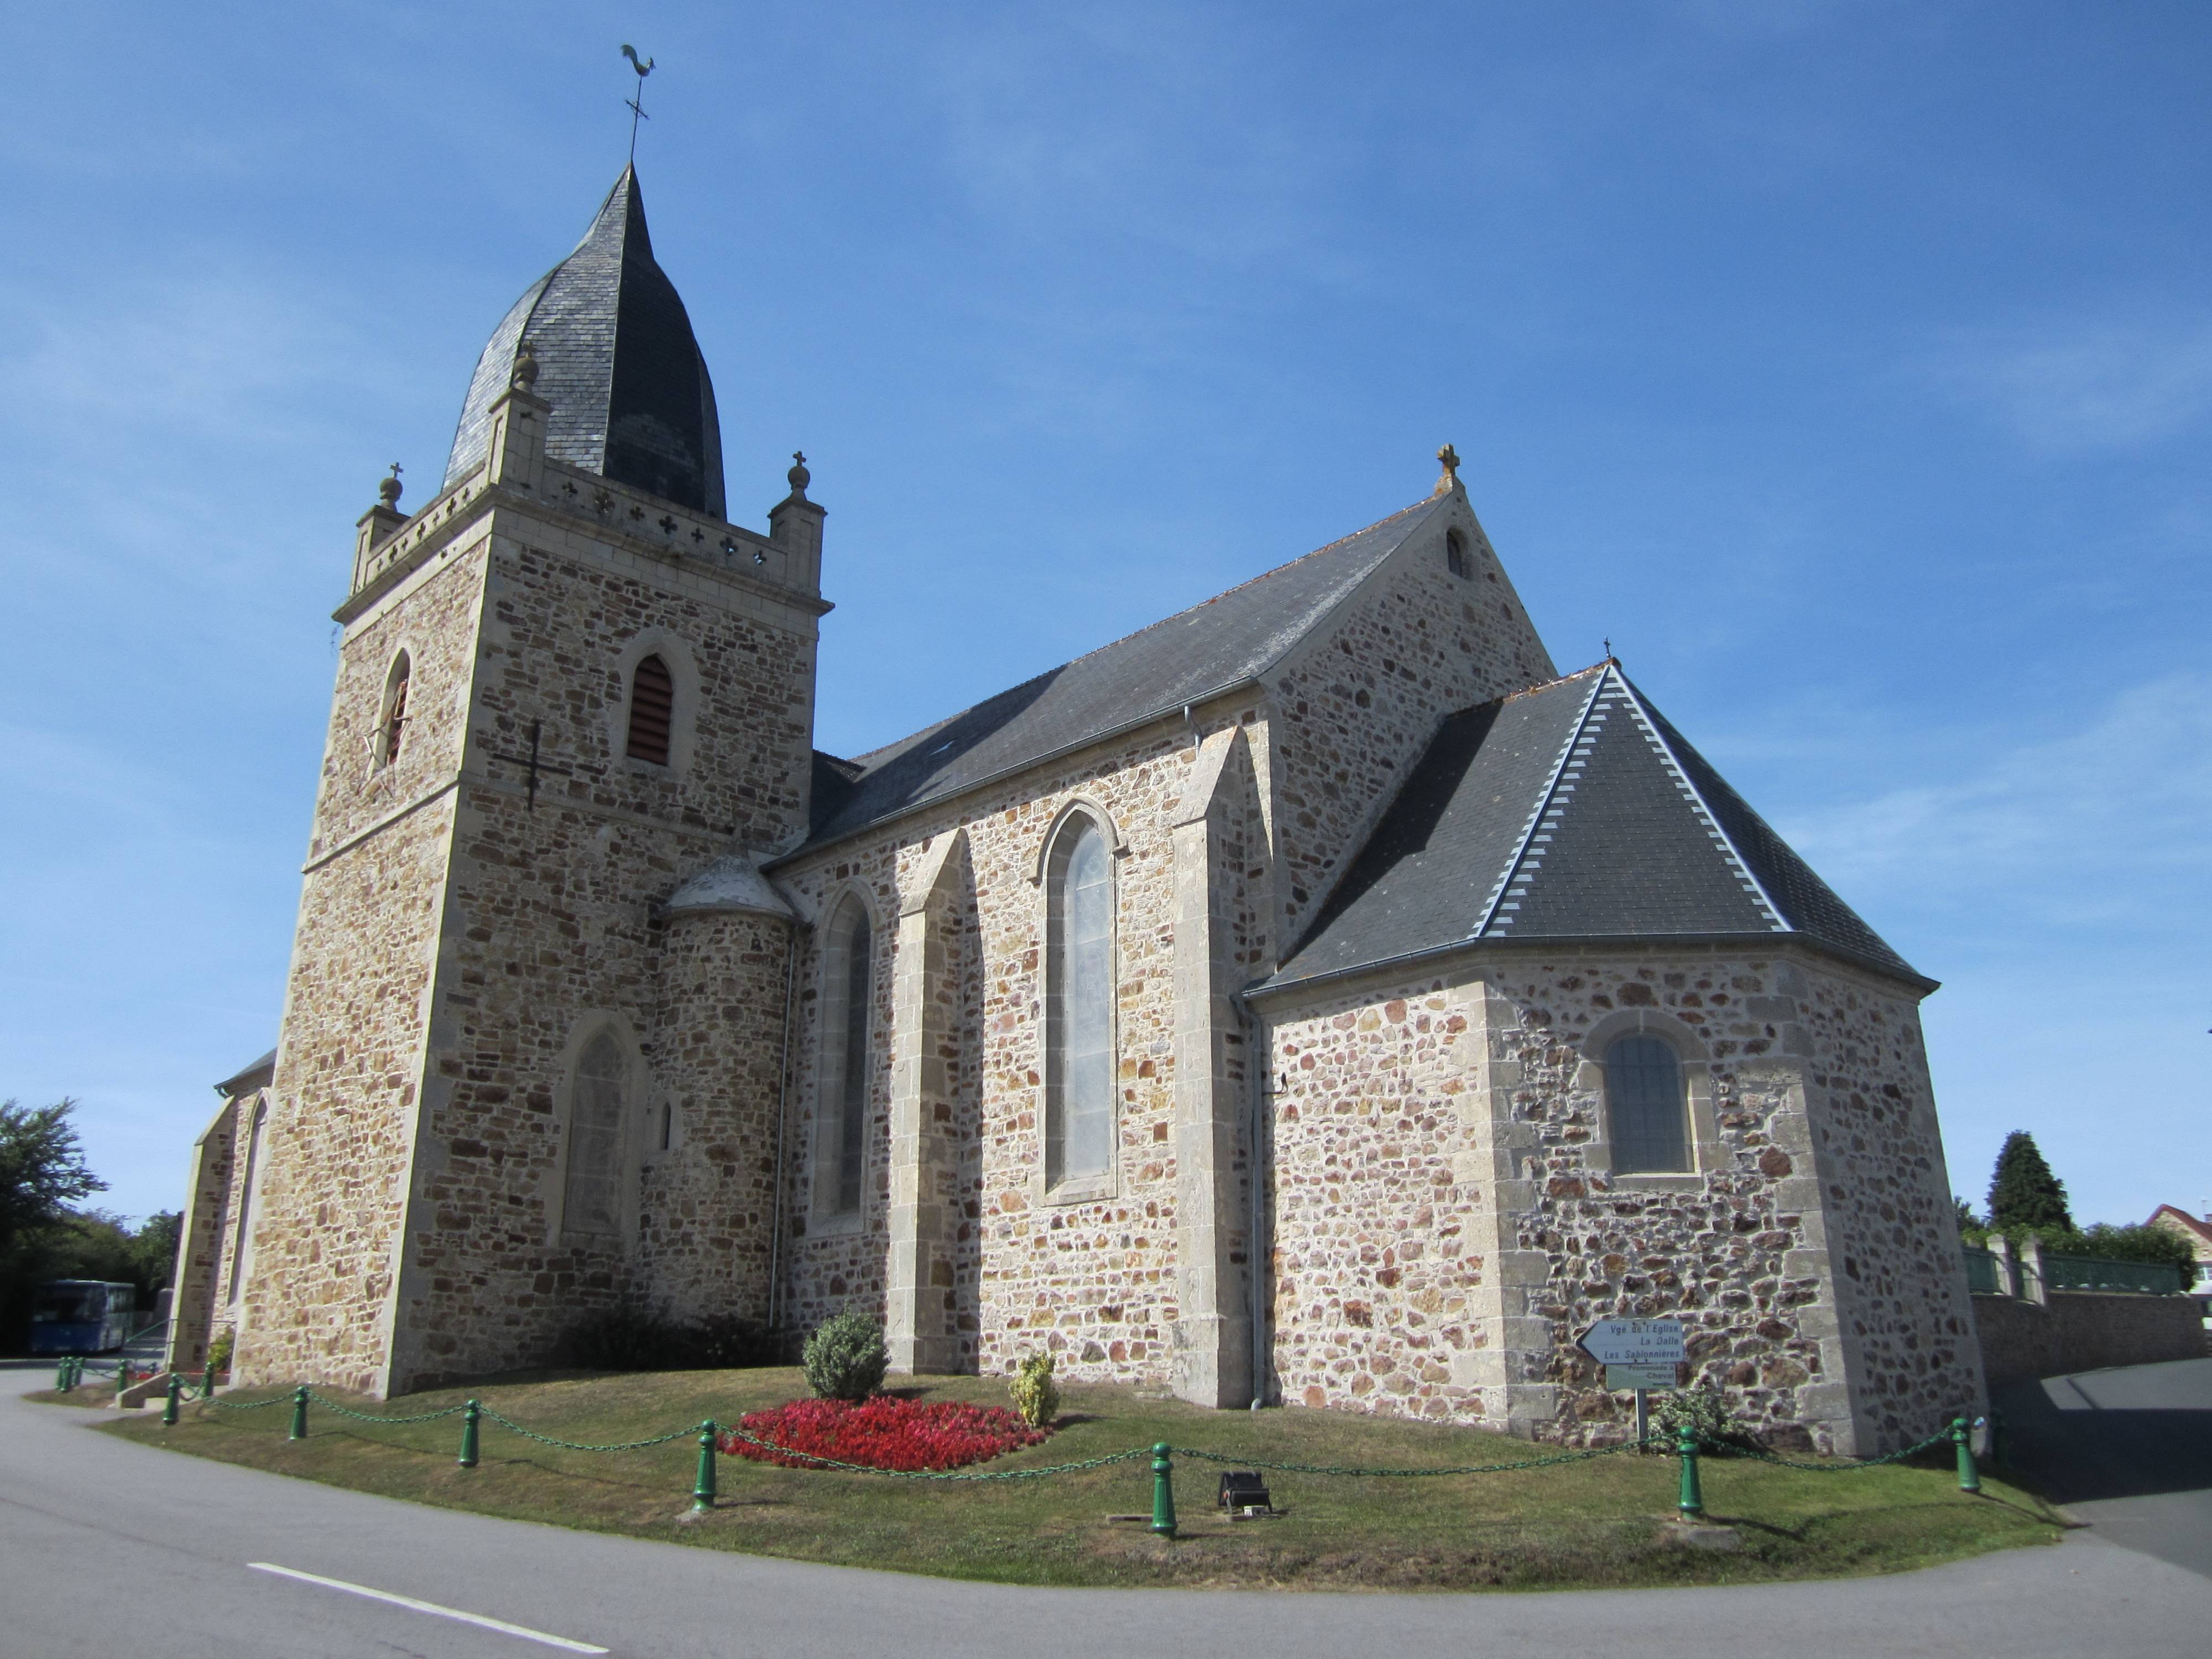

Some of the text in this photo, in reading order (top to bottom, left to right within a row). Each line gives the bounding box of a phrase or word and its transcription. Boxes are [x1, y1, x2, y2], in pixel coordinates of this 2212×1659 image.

[1632, 1324, 1642, 1333] de
[1641, 1337, 1679, 1345] La Dalle
[1605, 1350, 1619, 1359] Les
